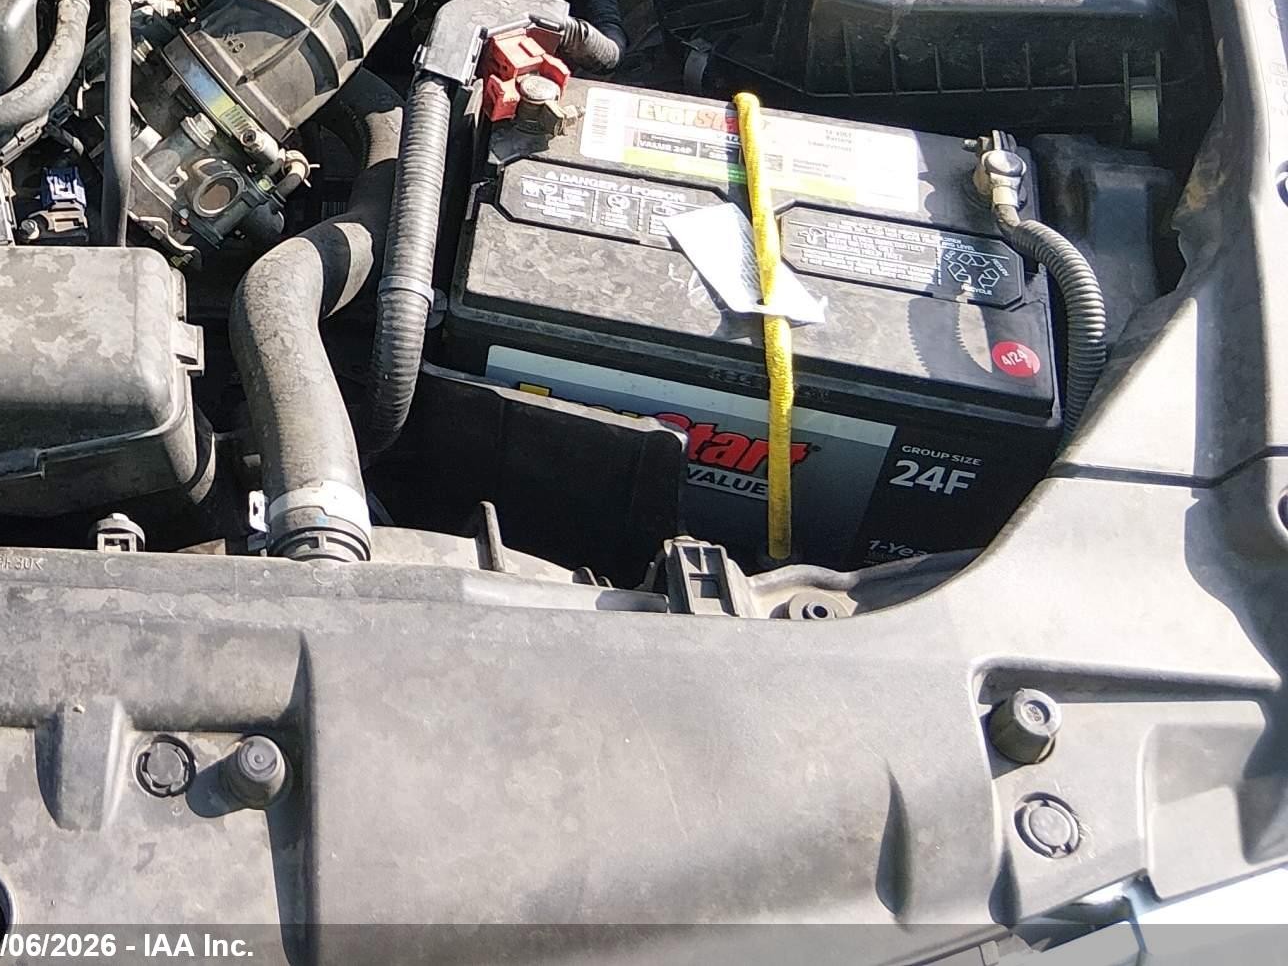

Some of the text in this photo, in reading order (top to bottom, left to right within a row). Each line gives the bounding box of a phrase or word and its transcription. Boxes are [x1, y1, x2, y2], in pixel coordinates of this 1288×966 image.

[560, 173, 617, 191] DANGER
[631, 186, 686, 203] POISON
[901, 445, 983, 467] GROUP SIZE
[687, 466, 770, 496] VALUE
[889, 459, 977, 495] 24F
